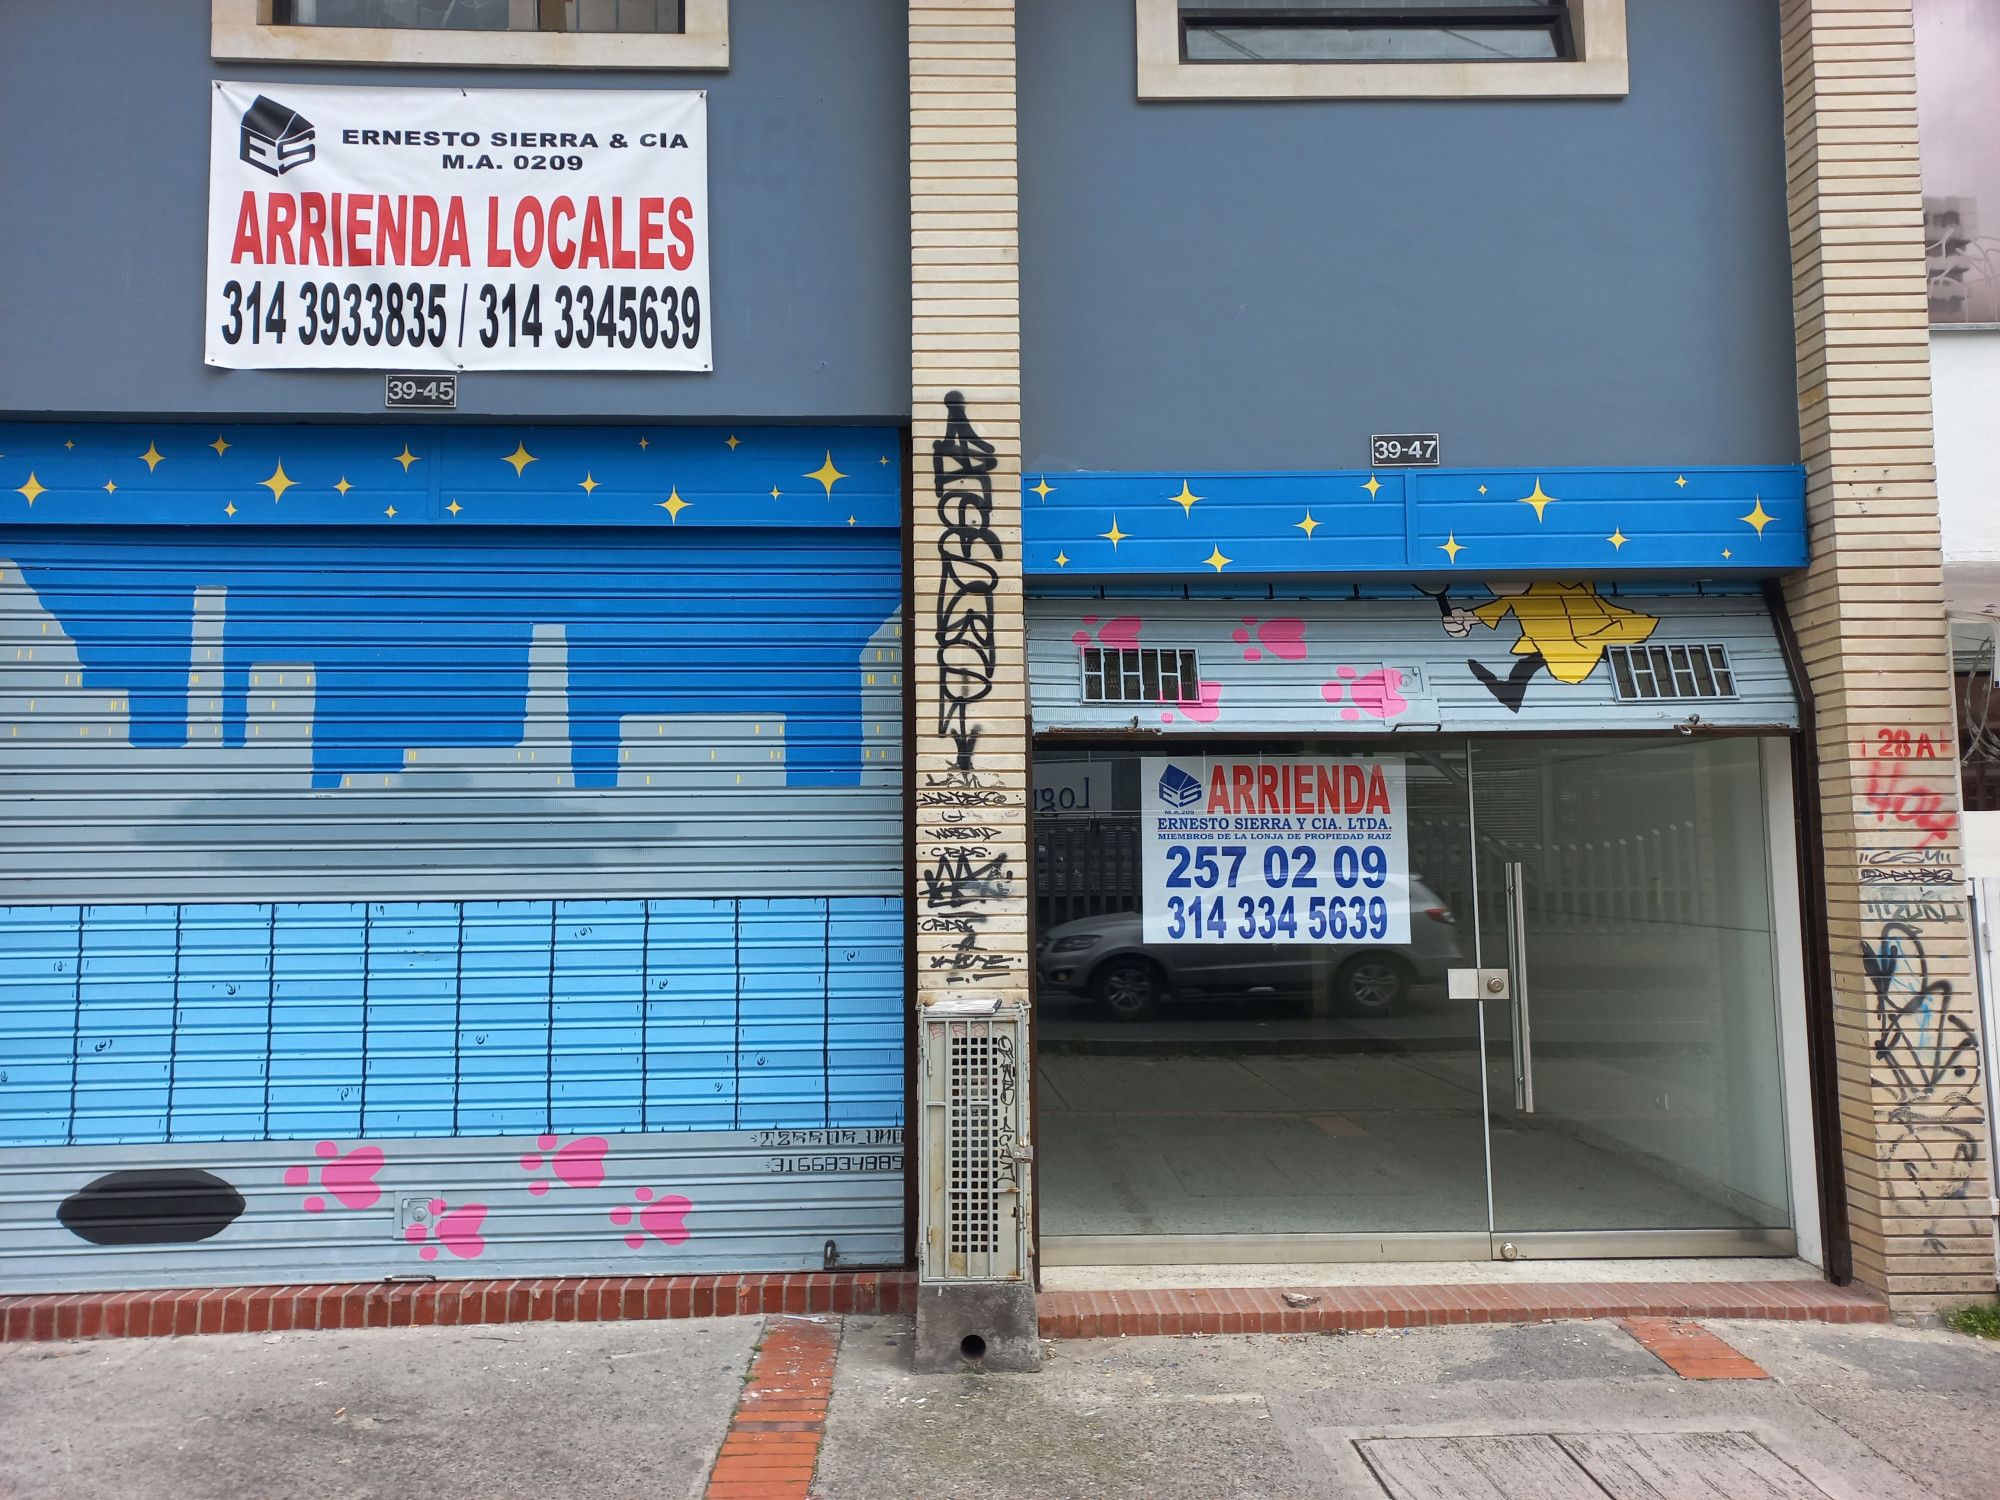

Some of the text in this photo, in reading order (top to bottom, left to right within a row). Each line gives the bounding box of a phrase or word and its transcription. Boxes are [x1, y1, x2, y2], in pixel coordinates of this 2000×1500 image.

[342, 129, 689, 149] ERNESTO SIERRA & CIA
[442, 154, 584, 171] M.A. 0209
[231, 190, 695, 270] ARRIENDA LOCALES
[222, 280, 700, 350] 314 3933835 / 314 3345639
[389, 381, 454, 401] 39-45
[1374, 440, 1437, 459] 39-47
[1206, 764, 1391, 815] ARRIENDA
[1157, 817, 1392, 831] ERNESTO SIERRA Y CIA. LTDA.
[1158, 833, 1214, 841] MIEMBROS
[1250, 833, 1284, 841] LONJA
[1166, 845, 1387, 889] 257 02 09
[1167, 895, 1388, 940] 314 334 5639
